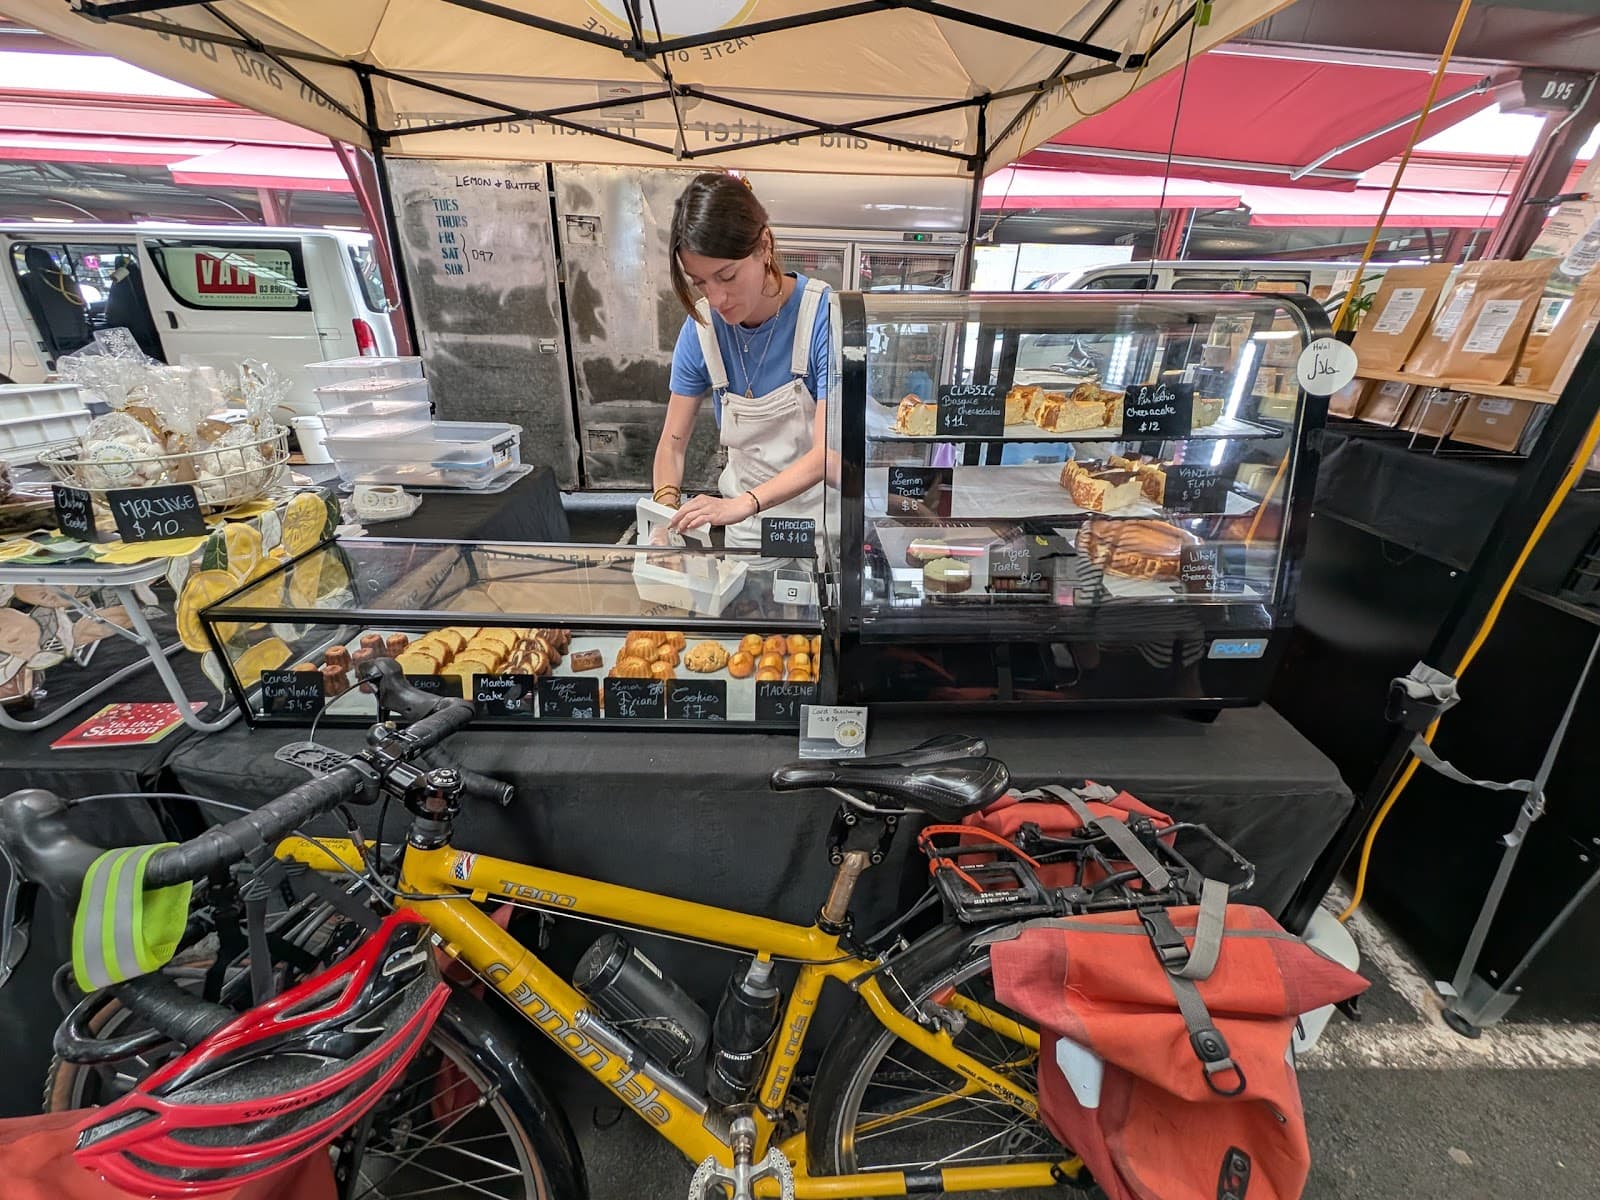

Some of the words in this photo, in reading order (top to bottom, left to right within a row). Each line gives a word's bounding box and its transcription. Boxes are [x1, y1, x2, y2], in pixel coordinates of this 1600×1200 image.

[455, 175, 492, 187] LEMON
[504, 179, 542, 193] BUTTER
[432, 198, 459, 212] TUES
[435, 215, 469, 229] THURS
[438, 231, 456, 244] FRI
[441, 247, 459, 260] SAT
[200, 259, 252, 286] VAN
[444, 263, 465, 275] SUN
[950, 384, 996, 397] CLASSIC
[1138, 421, 1160, 433] $12
[119, 494, 196, 520] MERINGE
[770, 531, 785, 542] FOR
[787, 530, 808, 543] $10
[671, 687, 719, 703] Cookies
[83, 724, 159, 737] Season
